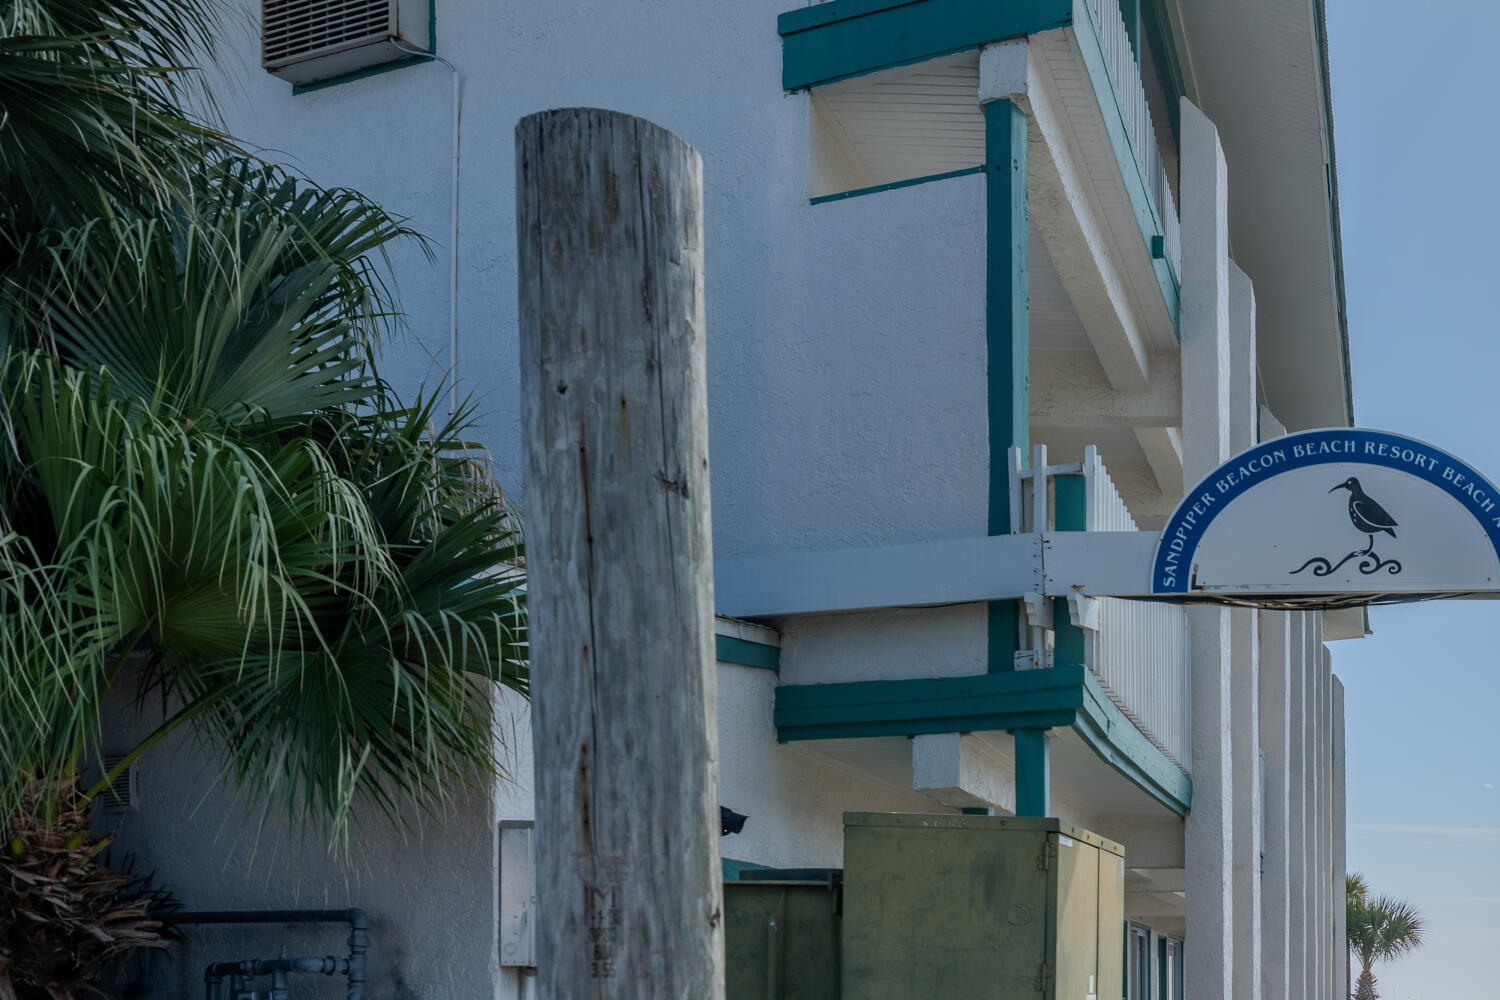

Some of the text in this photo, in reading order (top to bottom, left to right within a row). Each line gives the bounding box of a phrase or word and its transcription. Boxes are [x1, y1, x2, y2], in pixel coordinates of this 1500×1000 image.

[1163, 491, 1216, 587] SANDPIPER
[1215, 448, 1287, 494] BEACON
[1292, 439, 1356, 459] BEACH
[1364, 440, 1440, 472] RESORT
[1441, 465, 1496, 514] BEACH
